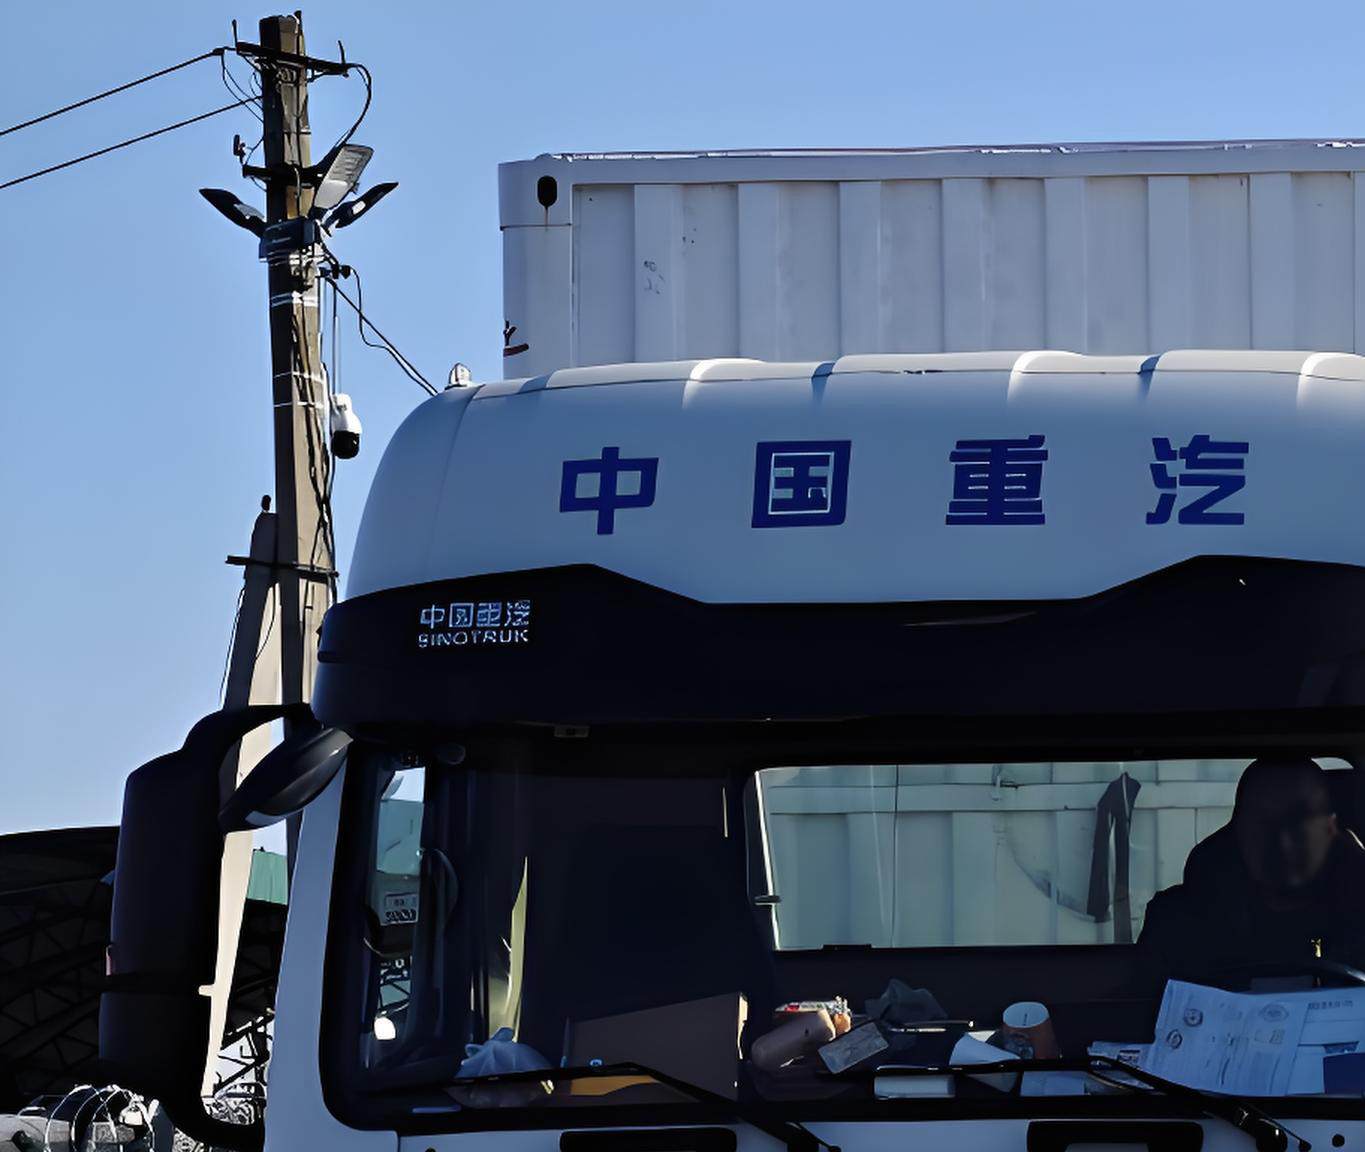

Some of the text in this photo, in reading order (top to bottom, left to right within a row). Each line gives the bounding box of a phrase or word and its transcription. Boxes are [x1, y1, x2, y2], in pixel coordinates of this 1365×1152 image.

[558, 433, 1251, 535] 中国重汽
[418, 629, 529, 648] SINOTRUK
